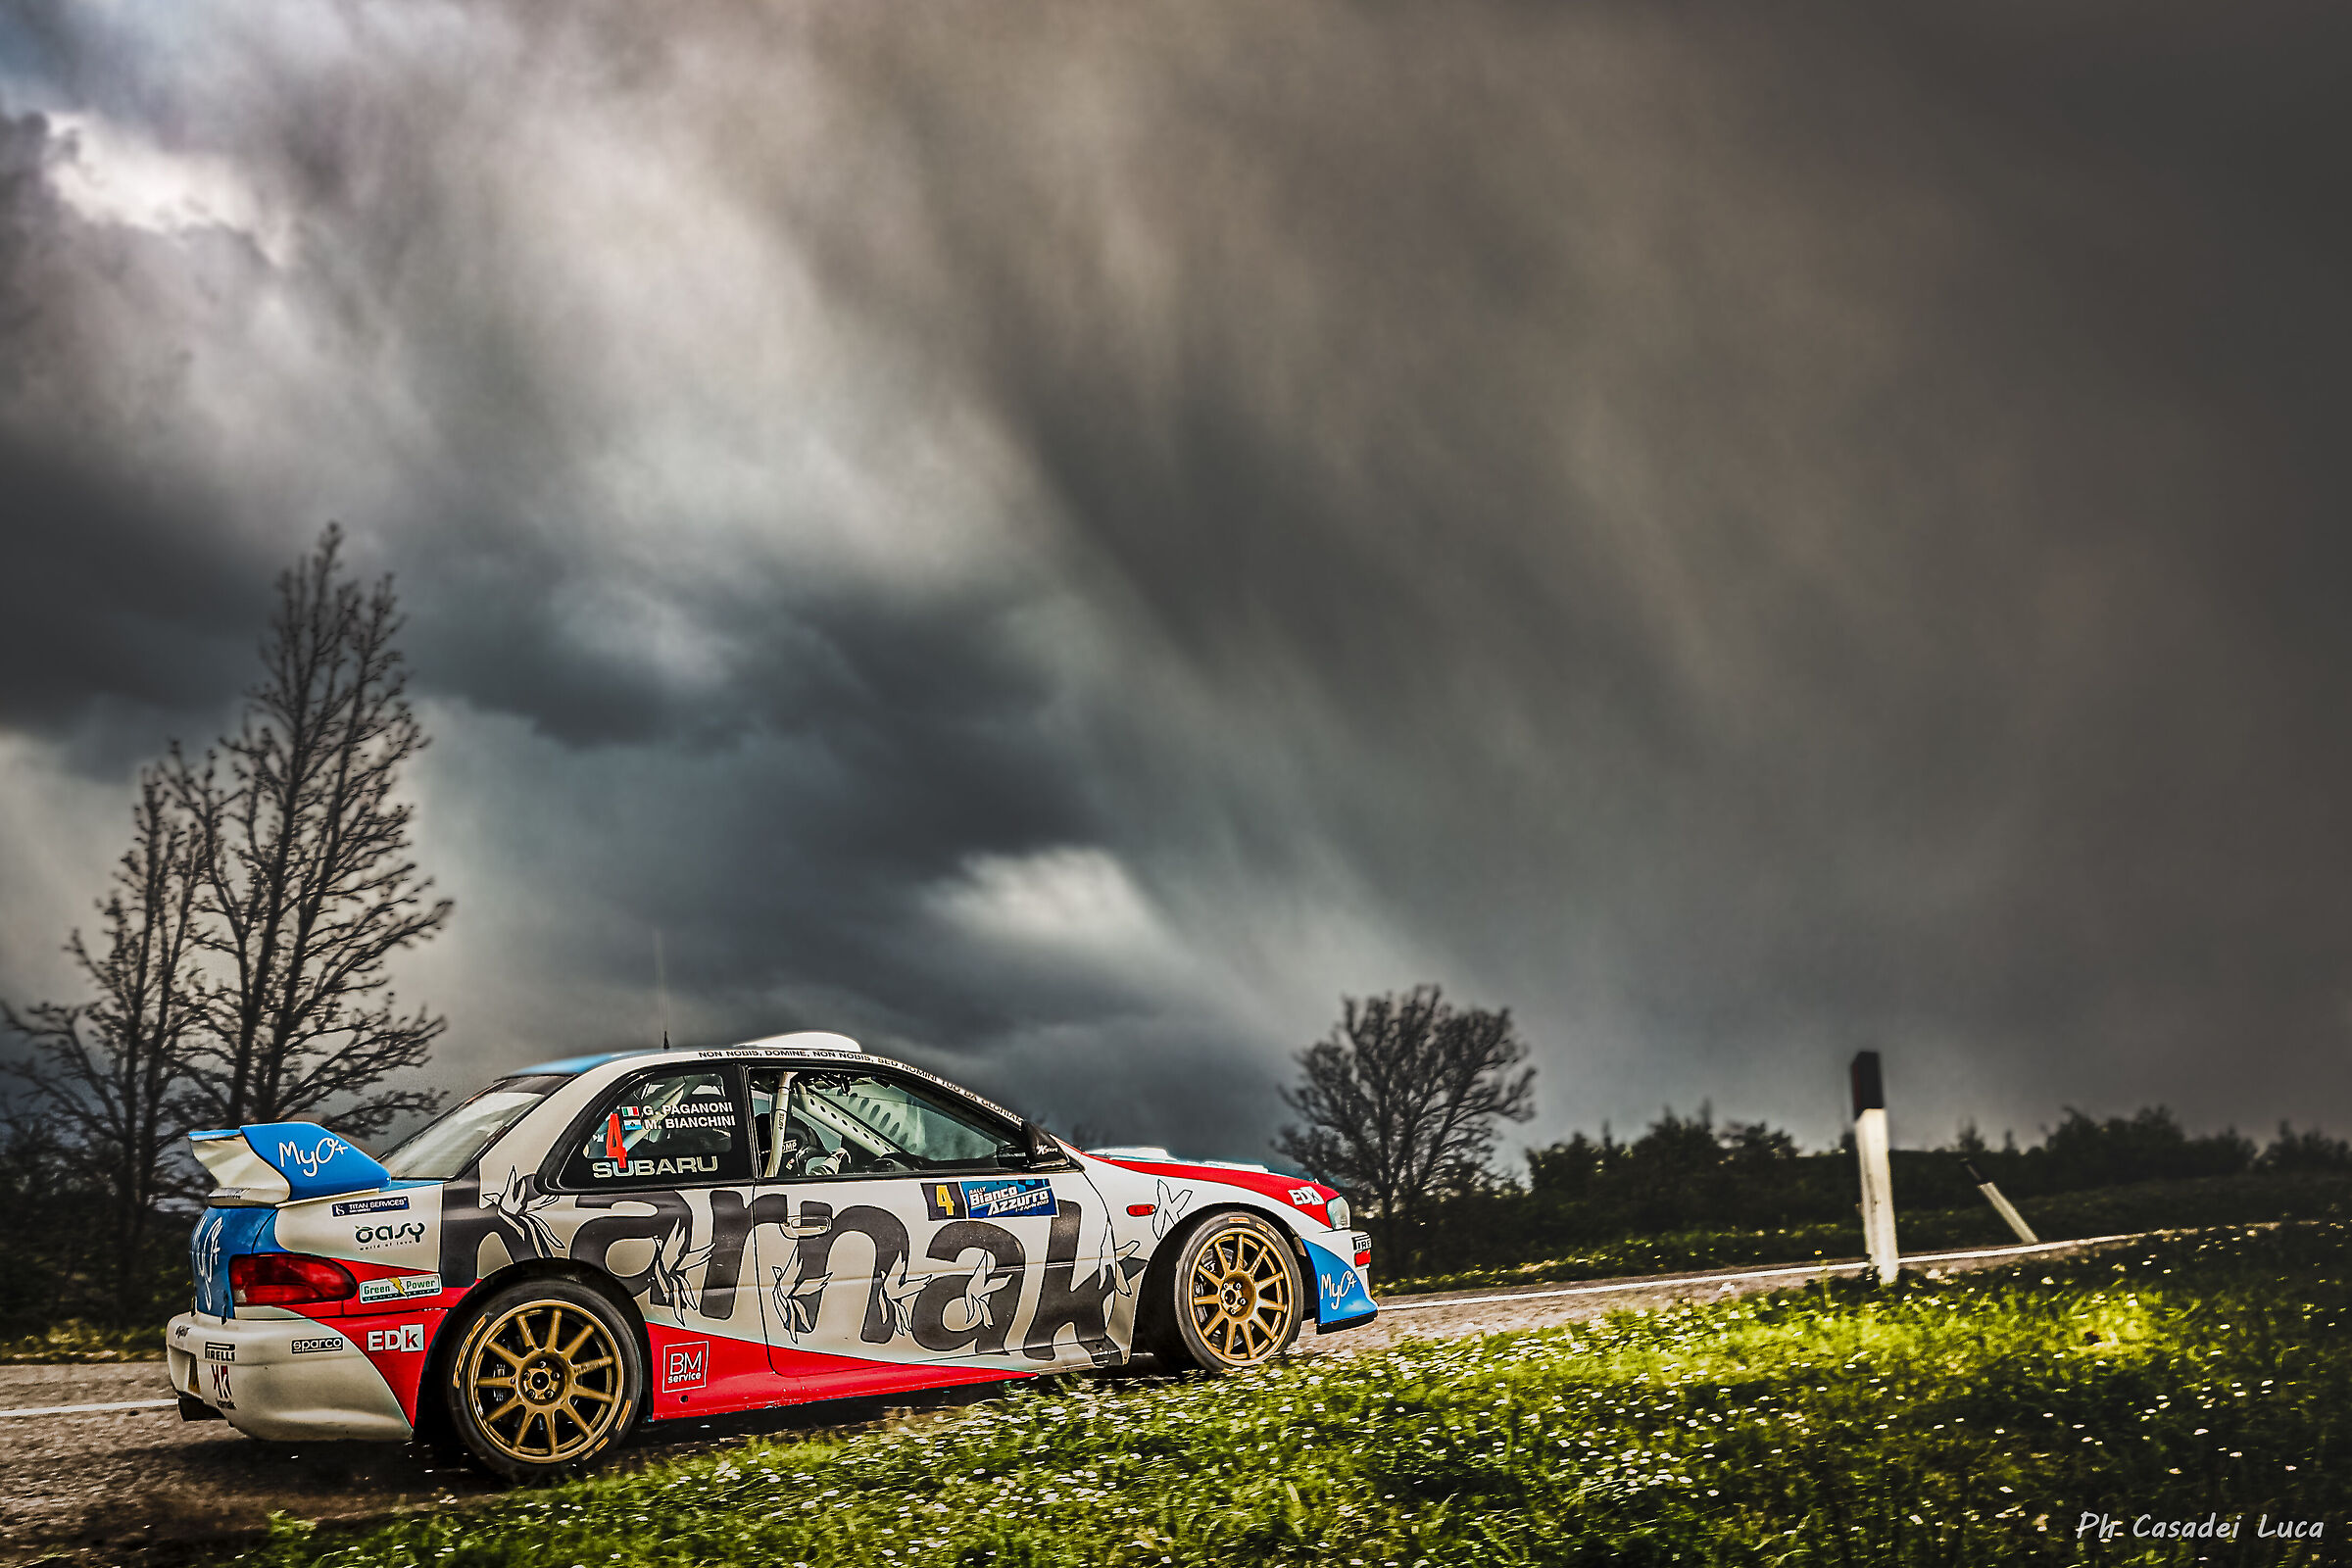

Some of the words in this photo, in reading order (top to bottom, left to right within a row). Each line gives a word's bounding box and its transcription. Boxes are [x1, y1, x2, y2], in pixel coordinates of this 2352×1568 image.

[643, 1105, 660, 1116] G.
[662, 1102, 733, 1116] PAGANONI
[644, 1118, 662, 1130] M.
[665, 1115, 736, 1129] BIANCHINI
[606, 1113, 627, 1169] 4
[592, 1155, 718, 1179] SUBARU
[968, 1186, 987, 1196] RALLY
[970, 1186, 1018, 1206] Bianco
[348, 1202, 368, 1211] TITAN
[369, 1198, 405, 1209] SERVICES
[936, 1184, 955, 1216] 4
[987, 1190, 1049, 1216] Azzurro
[1351, 1234, 1371, 1250] PIRE
[364, 1285, 391, 1295] Green
[406, 1280, 435, 1290] Power
[205, 1341, 236, 1362] PIRELLI
[292, 1338, 342, 1352] sparco
[670, 1350, 702, 1375] BM
[667, 1372, 702, 1384] service
